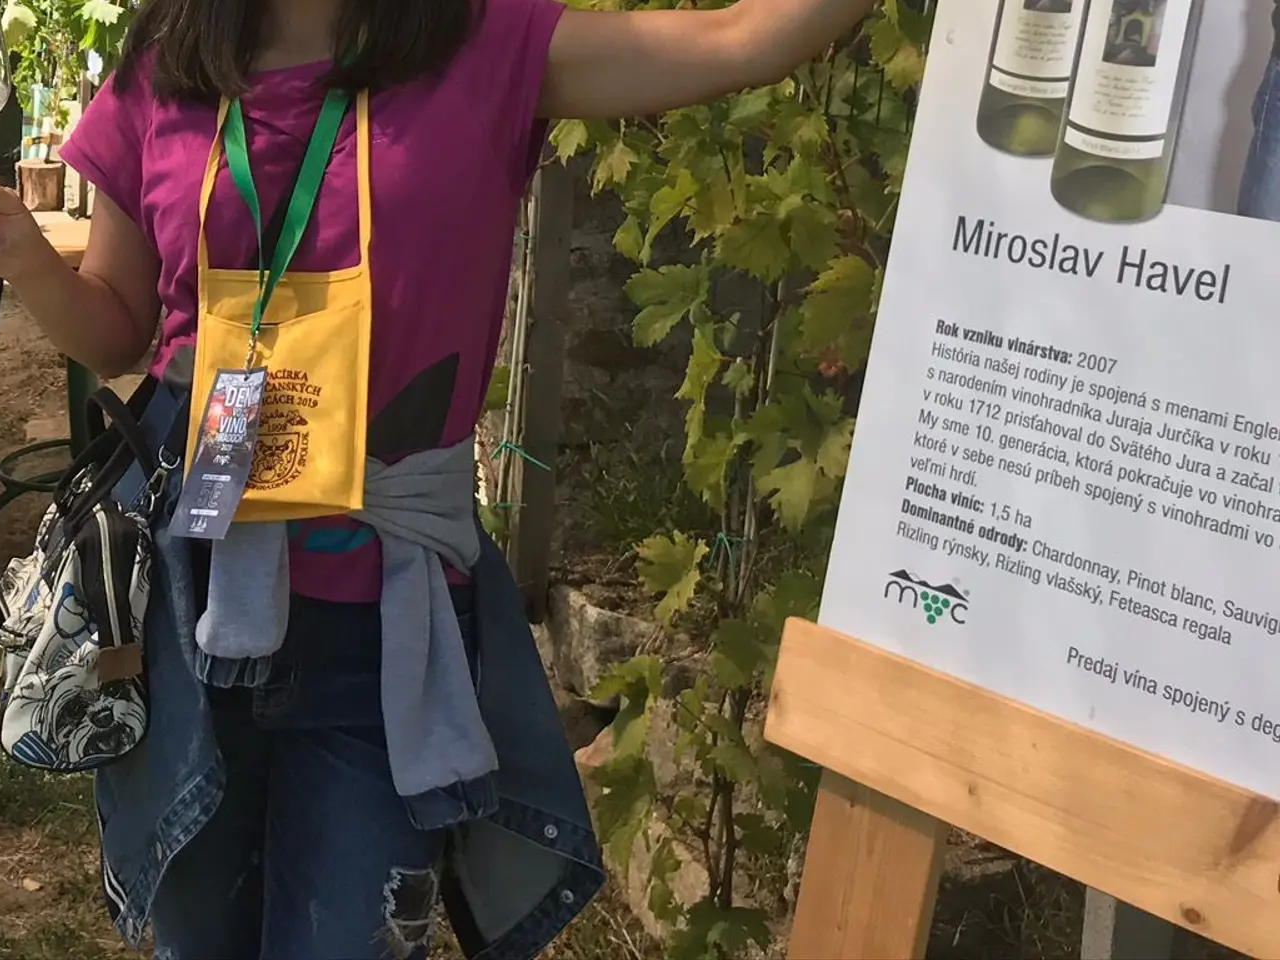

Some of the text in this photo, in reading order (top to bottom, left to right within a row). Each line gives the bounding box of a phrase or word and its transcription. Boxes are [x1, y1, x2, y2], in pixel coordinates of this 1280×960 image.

[952, 215, 1231, 304] Miroslav Havel
[931, 341, 980, 368] História
[984, 357, 1021, 380] našej
[1023, 367, 1068, 391] rodiny
[1069, 375, 1085, 394] je
[1088, 383, 1147, 409] spojená
[1151, 398, 1161, 412] s
[1165, 401, 1229, 428] menami
[935, 319, 1118, 374] Rok vzniku vinárstva: 2007
[918, 408, 939, 430] My
[942, 418, 970, 436] sme
[976, 424, 994, 444] 10.
[998, 434, 1070, 467] generácia,
[1075, 451, 1113, 476] ktorá
[1117, 467, 1193, 499] pokračuje
[1198, 488, 1217, 505] vo
[923, 389, 1274, 493] v roku 1712 prisťahoval do Svätého Jura a začal
[927, 367, 1271, 465] s narodením vinohradníka Juraja Jurčíka v roku
[905, 475, 1032, 529] Plocha viníc: 1,5 ha
[910, 456, 977, 487] veľmi hrdí.
[913, 430, 1274, 548] ktoré v sebe nesú príbeh spojený s vinohradmi vo
[896, 520, 1232, 645] Rizling rýnsky, Rizling vlašský, Feteasca regala
[901, 498, 975, 535] Dominantné
[978, 526, 1028, 553] odrody:
[1032, 540, 1121, 585] Chardonnay,
[1127, 569, 1167, 597] Pinot
[1170, 583, 1216, 616] blanc,
[1067, 646, 1119, 684] Predaj
[1123, 669, 1158, 695] vína
[1162, 685, 1231, 723] spojený
[1234, 710, 1246, 726] s
